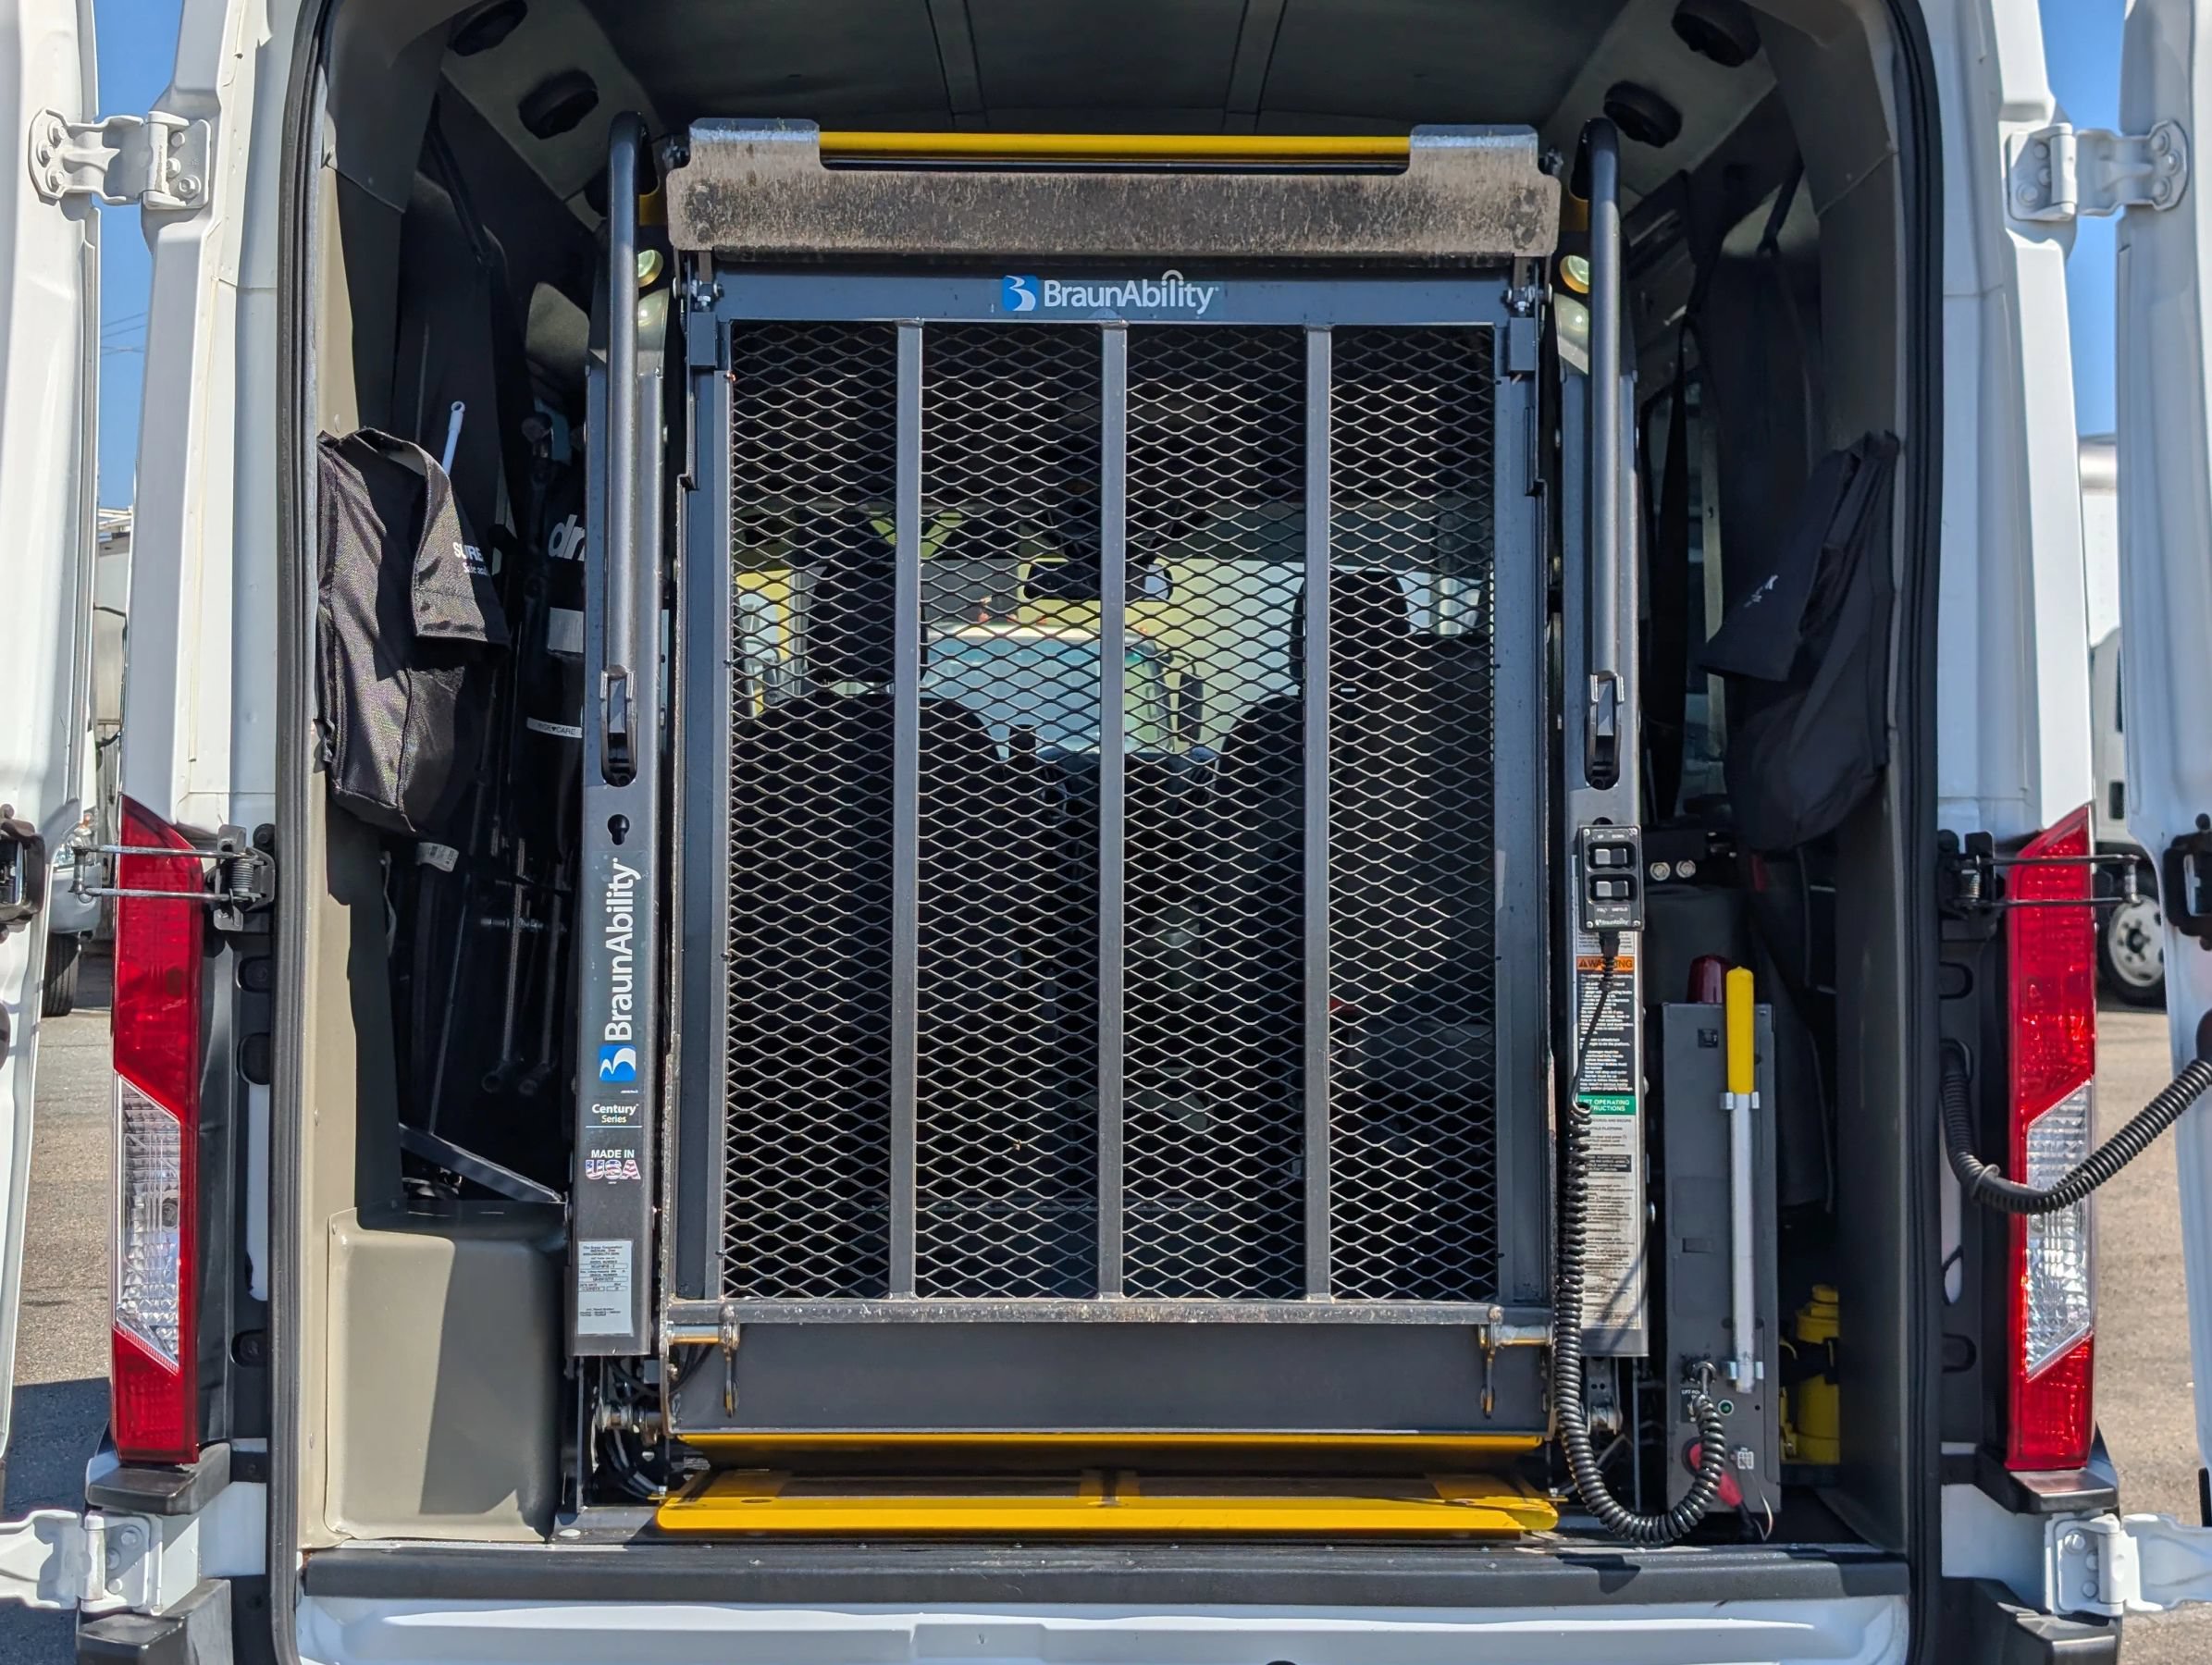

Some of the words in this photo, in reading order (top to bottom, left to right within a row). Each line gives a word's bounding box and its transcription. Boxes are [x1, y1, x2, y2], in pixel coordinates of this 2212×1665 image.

[1044, 276, 1214, 315] BraunAbility
[604, 862, 642, 1042] BraunAbility
[592, 1104, 636, 1116] Century
[601, 1115, 627, 1123] Series
[591, 1150, 622, 1158] MADE
[624, 1150, 635, 1158] IN
[586, 1159, 641, 1179] USA
